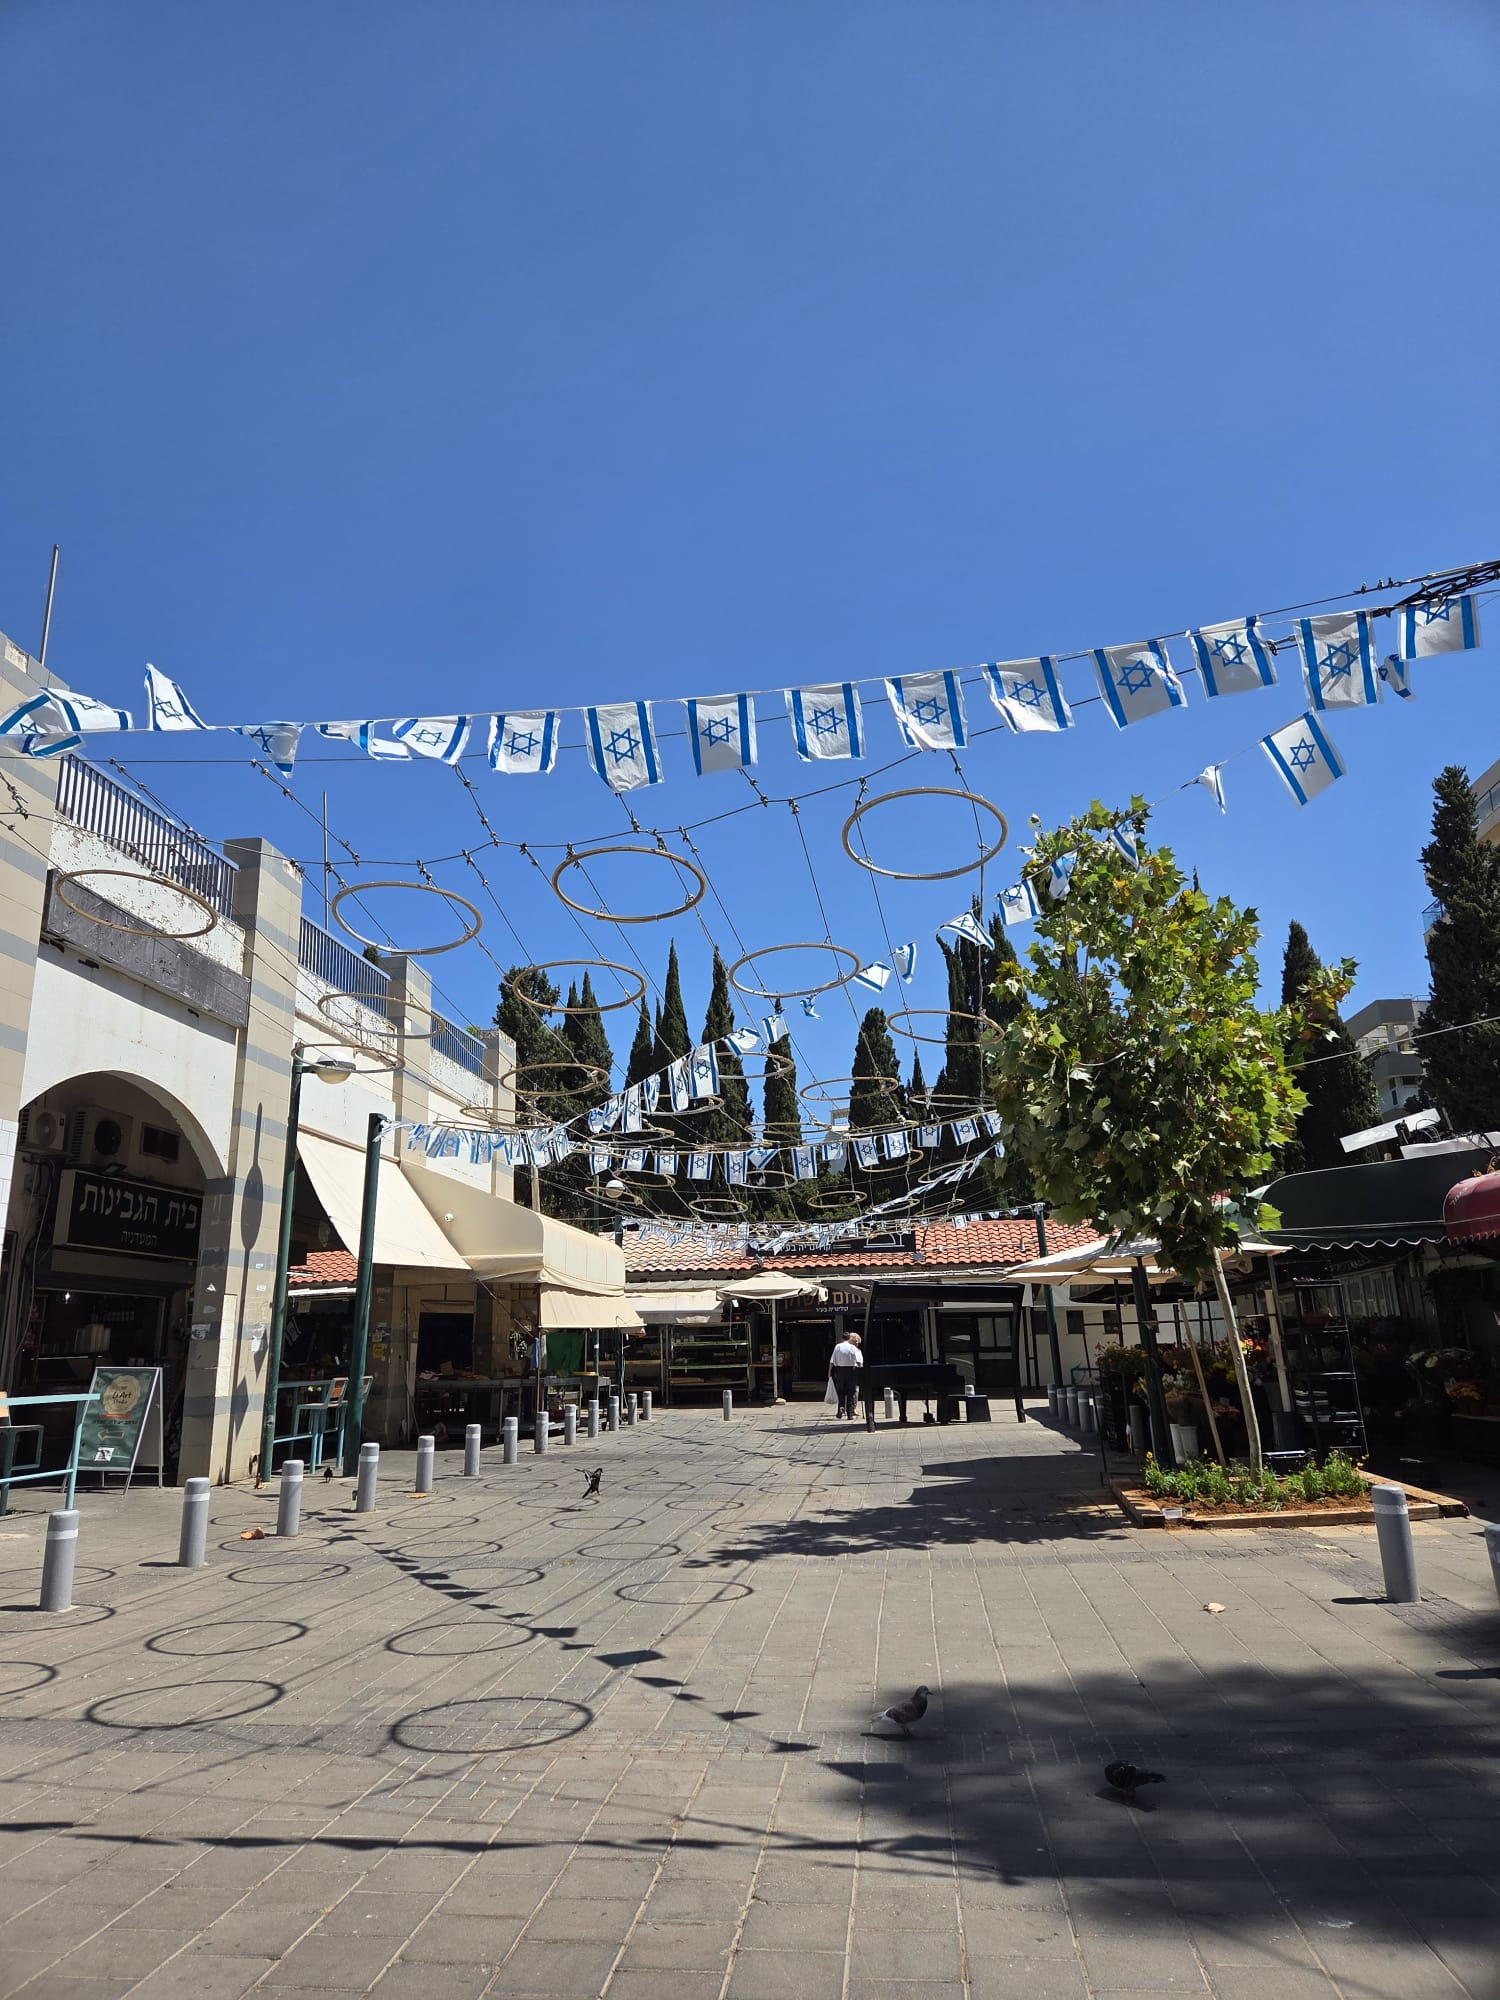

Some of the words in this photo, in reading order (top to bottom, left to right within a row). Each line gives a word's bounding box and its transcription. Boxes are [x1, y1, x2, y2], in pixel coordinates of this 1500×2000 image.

[79, 1183, 159, 1224] הגבינות
[163, 1199, 198, 1230] בית
[121, 1230, 158, 1248] המעדניה
